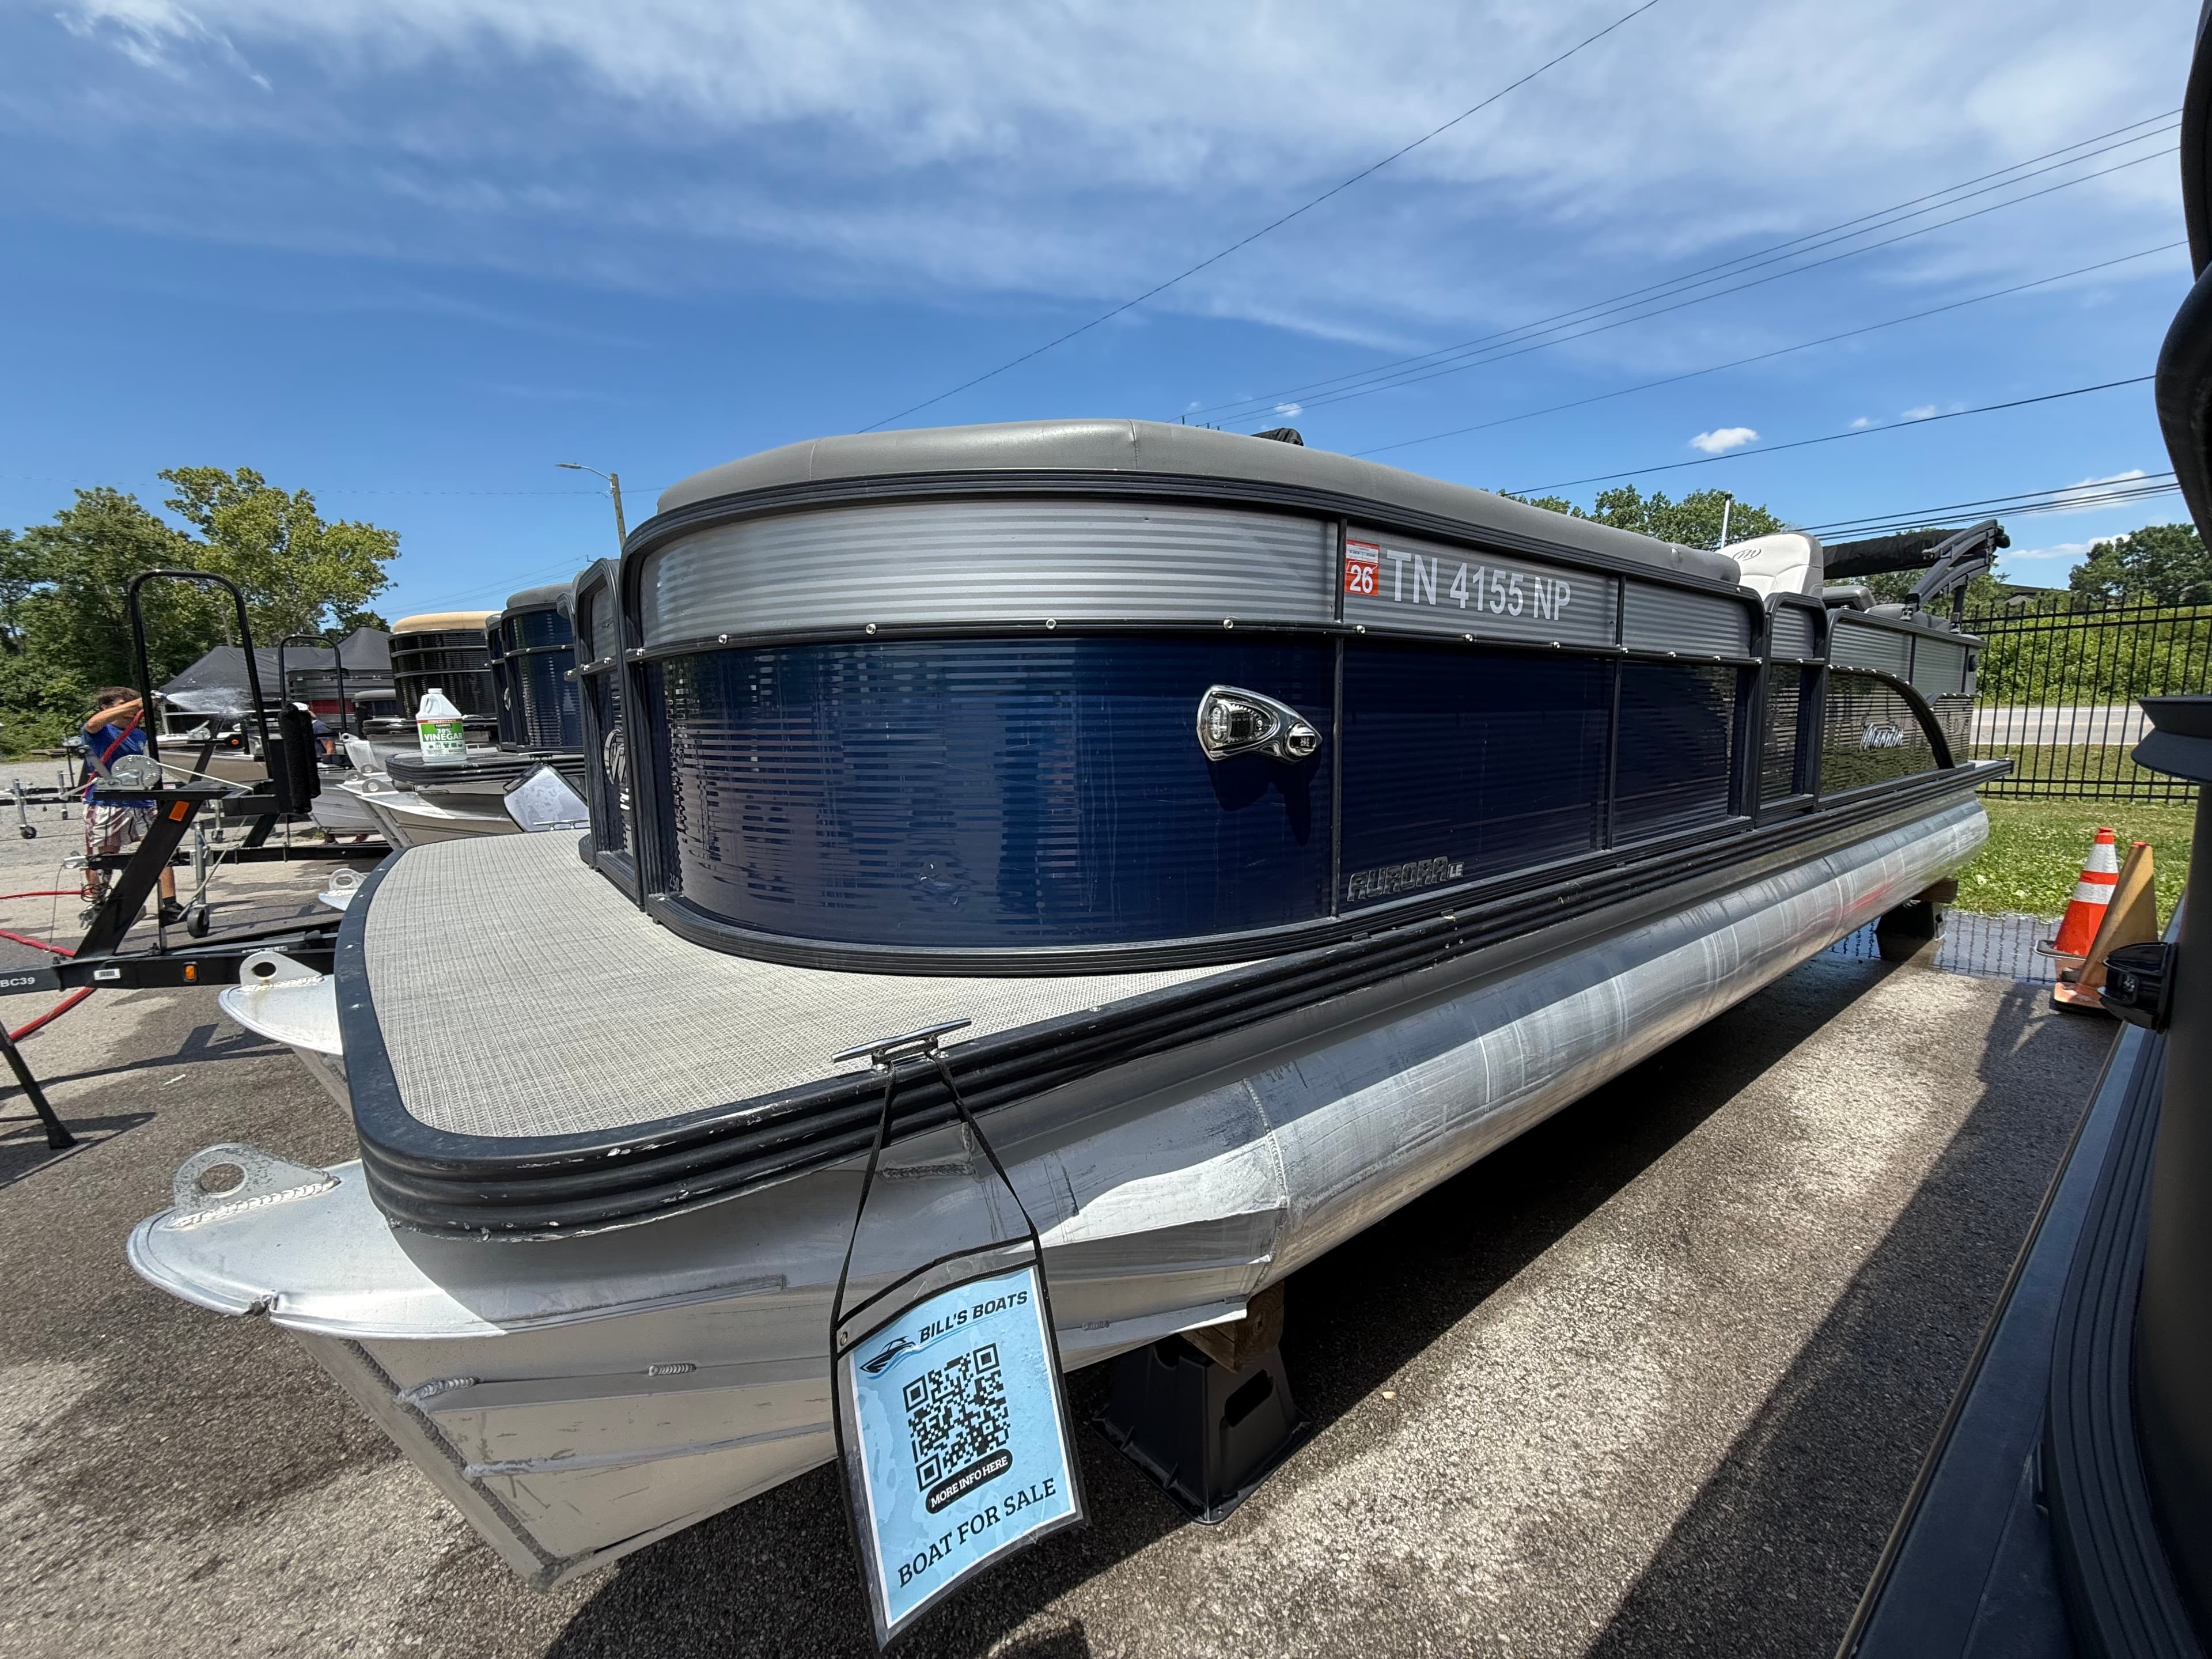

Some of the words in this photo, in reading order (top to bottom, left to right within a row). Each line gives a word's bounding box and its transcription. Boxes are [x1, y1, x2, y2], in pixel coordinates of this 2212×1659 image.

[1350, 565, 1373, 593] 26
[1387, 550, 1438, 605] TN
[1449, 562, 1524, 617] 4155
[1533, 576, 1571, 620] NP
[423, 733, 463, 741] VINEGAR
[1347, 856, 1448, 902] AURORA
[1449, 864, 1463, 878] LE
[918, 1309, 968, 1343] BILL'S
[970, 1291, 1028, 1319] BOATS
[930, 1483, 959, 1508] MORE
[959, 1470, 982, 1490] INFO
[982, 1456, 1008, 1476] HERE
[898, 1532, 952, 1588] BOAT
[957, 1505, 1001, 1545] FOR
[1003, 1478, 1056, 1517] SALE
